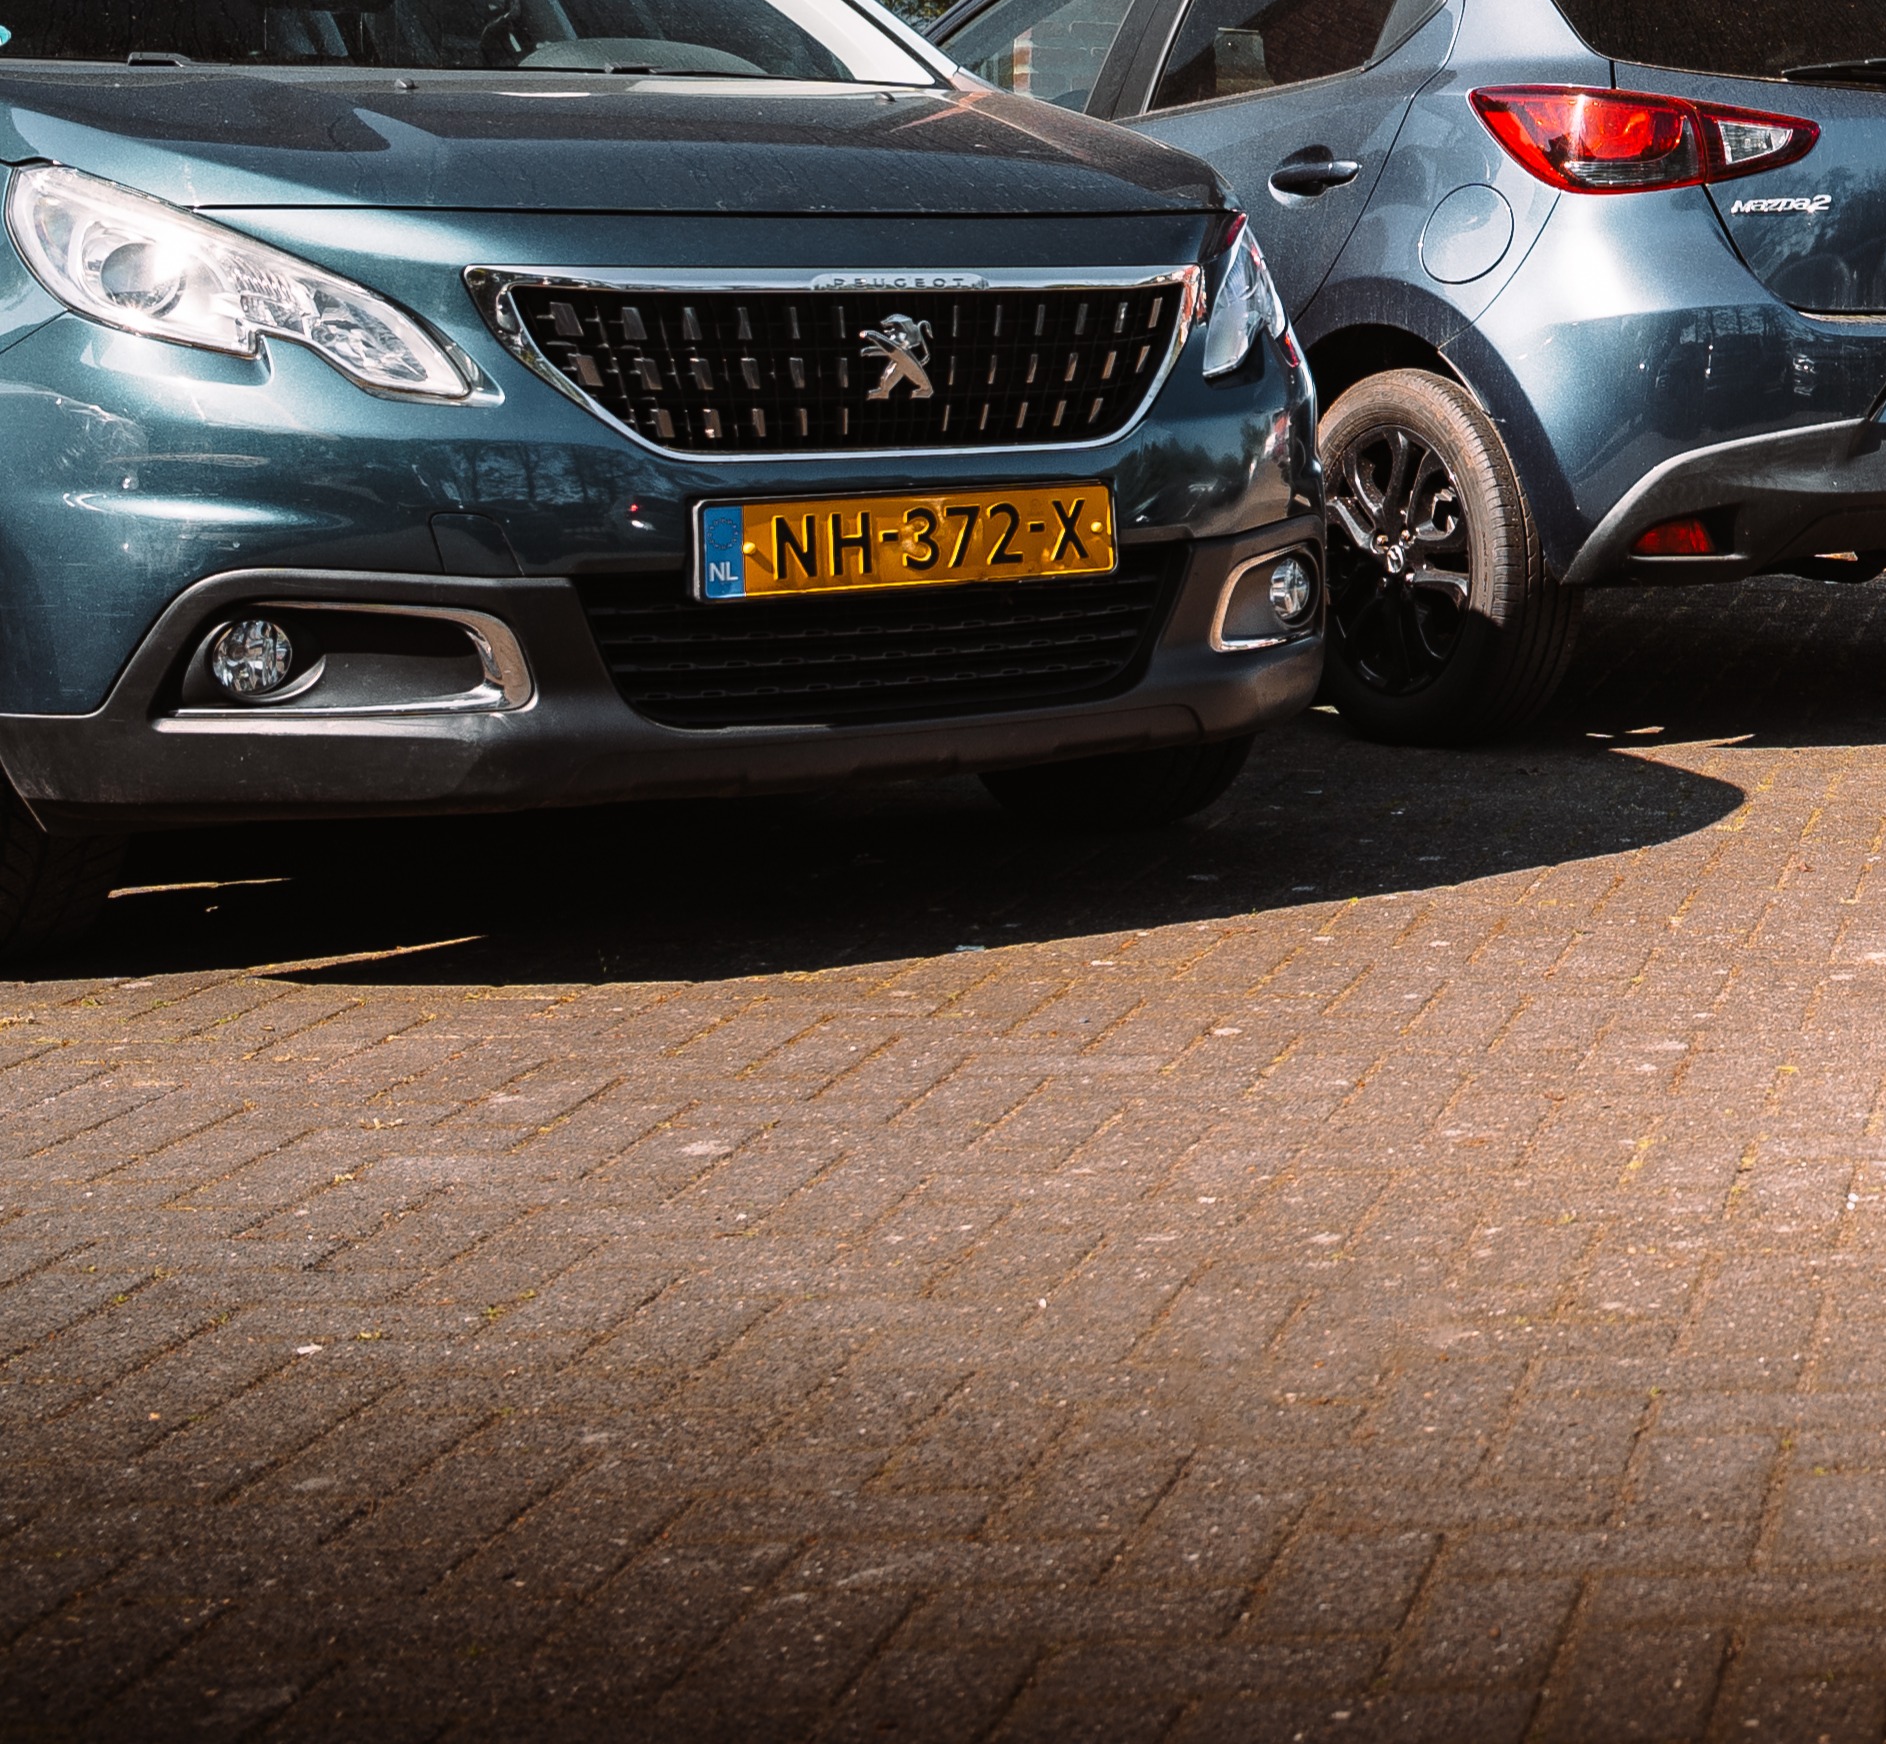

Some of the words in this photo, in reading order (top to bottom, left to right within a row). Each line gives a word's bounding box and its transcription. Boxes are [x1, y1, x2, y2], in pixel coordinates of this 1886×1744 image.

[833, 277, 965, 289] PEUGEOT
[772, 497, 1091, 581] NH-372-X
[708, 561, 738, 582] NL
